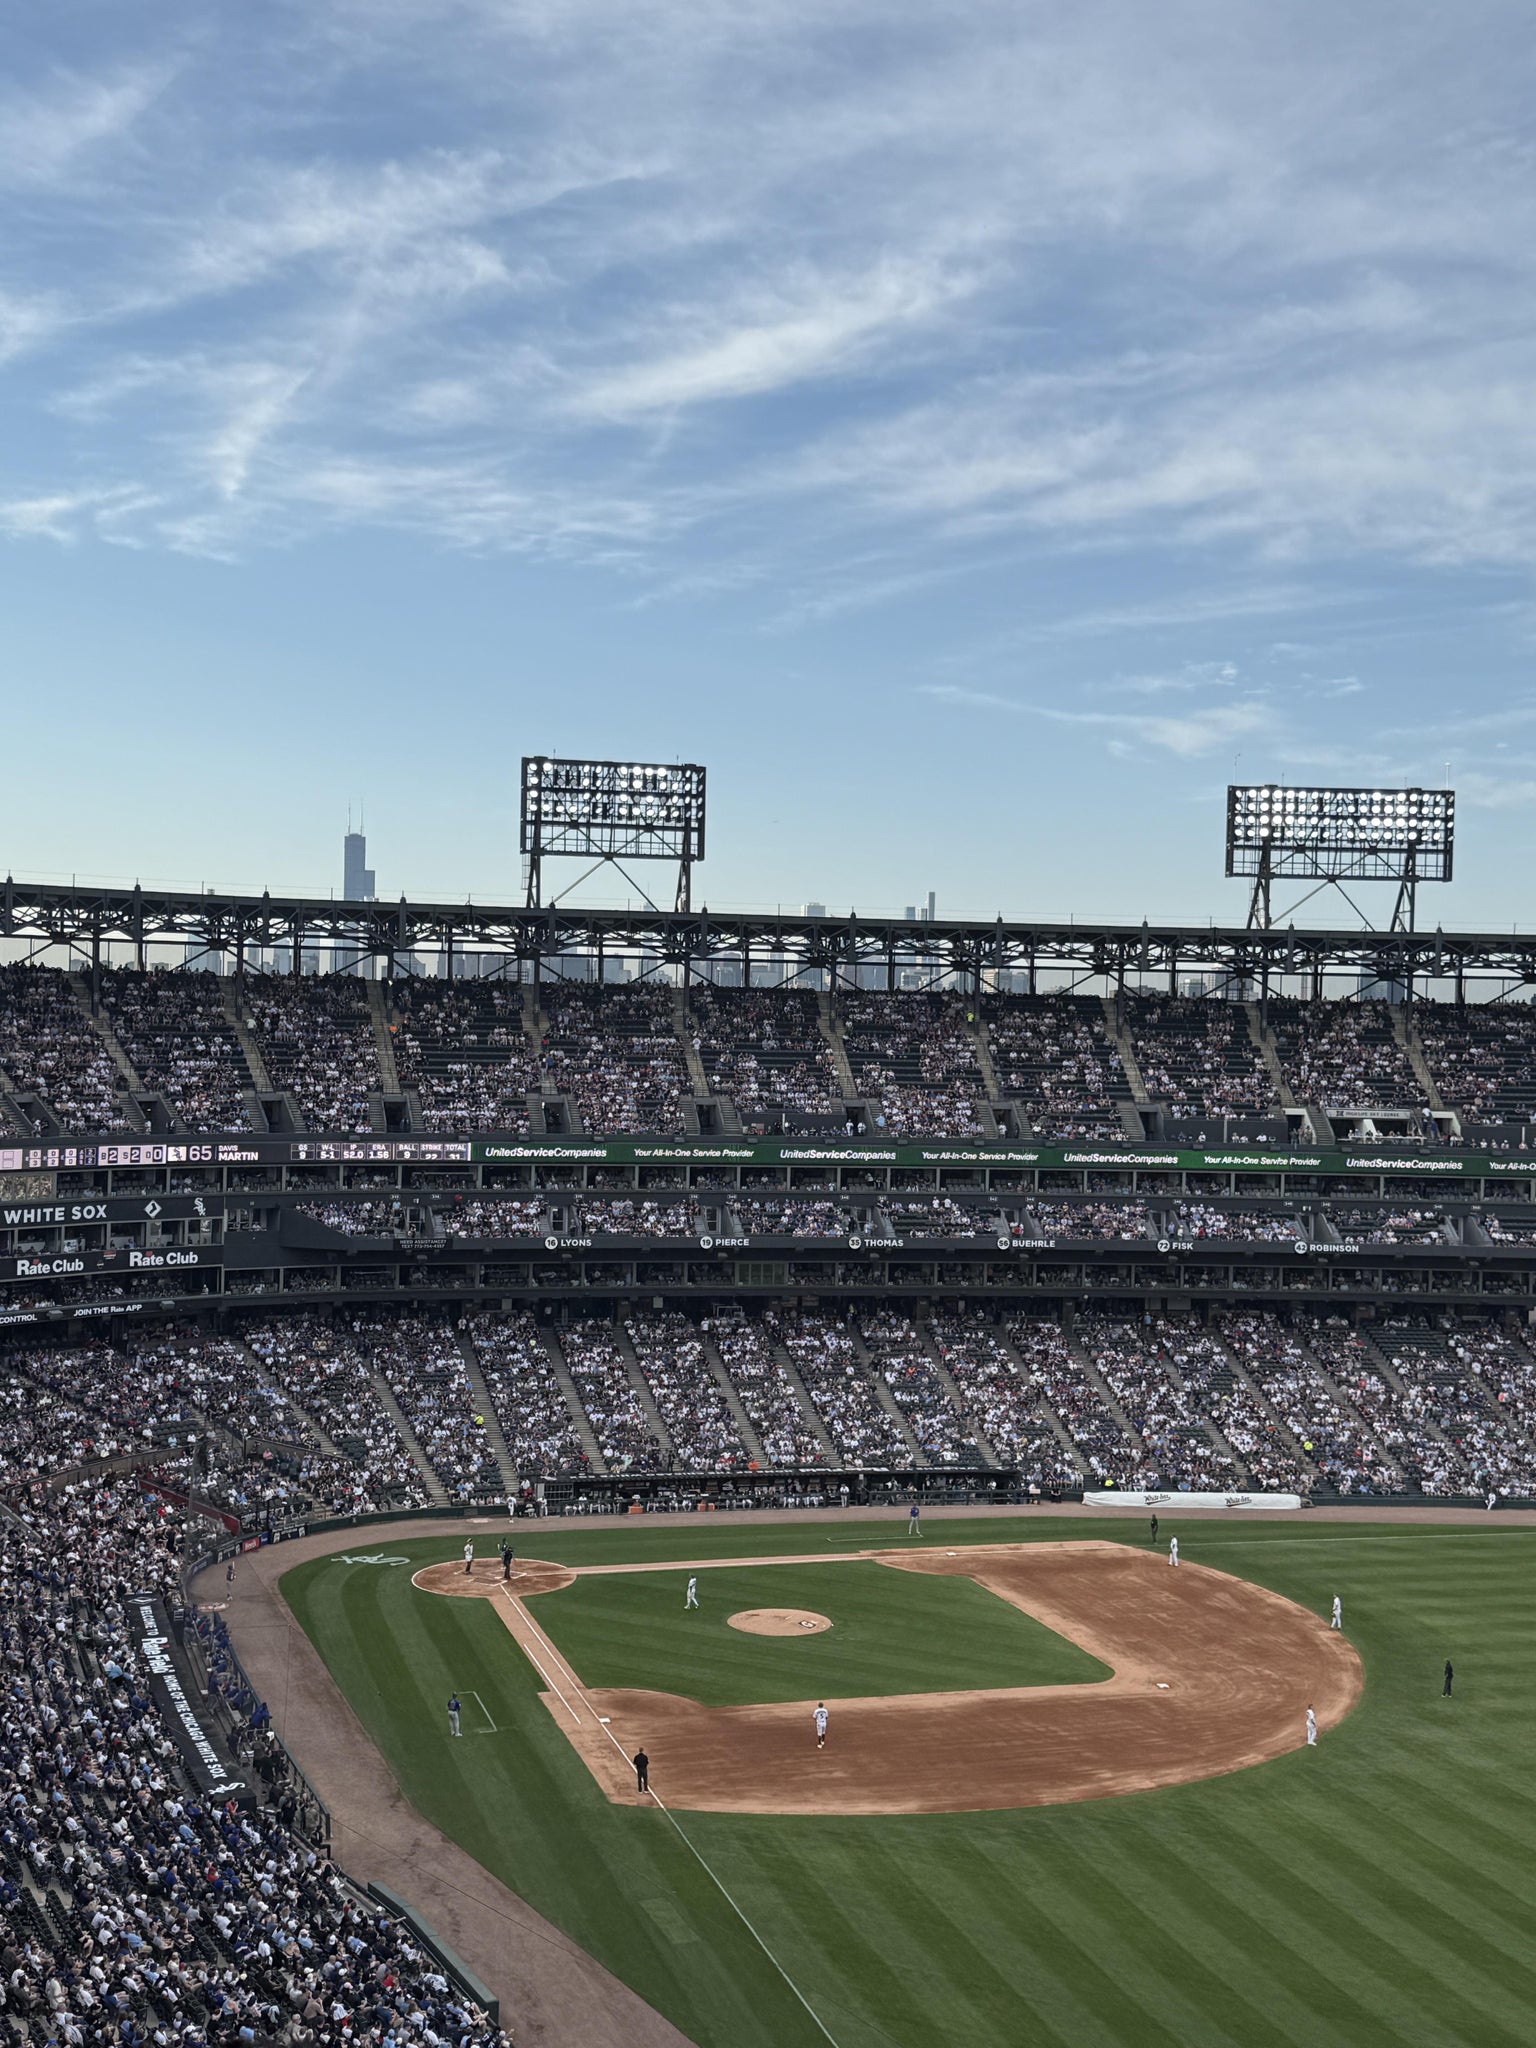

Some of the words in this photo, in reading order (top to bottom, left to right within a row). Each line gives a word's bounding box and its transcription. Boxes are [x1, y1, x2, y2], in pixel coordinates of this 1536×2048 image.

[109, 1150, 117, 1161] 2
[131, 1149, 140, 1161] 2
[154, 1149, 162, 1160] 0
[189, 1146, 212, 1161] 65
[218, 1152, 259, 1161] MARTIN
[299, 1151, 307, 1160] 9
[321, 1151, 335, 1159] 5-1
[343, 1151, 363, 1159] 52.0
[369, 1151, 390, 1159] 1.56
[404, 1151, 411, 1159] 9
[485, 1147, 607, 1159] UnitedServiceCompanies
[634, 1148, 652, 1157] Your
[653, 1149, 690, 1157] All-In-One
[692, 1149, 721, 1157] Service
[722, 1149, 755, 1158] Provider
[780, 1149, 896, 1161] UnitedServiceCompanies
[922, 1152, 940, 1160] Your
[940, 1152, 977, 1160] All-In-One
[979, 1153, 1006, 1161] Service
[1008, 1153, 1039, 1162] Provider
[1064, 1152, 1178, 1165] UnitedServiceCompanies
[1204, 1155, 1220, 1163] Your
[1221, 1156, 1259, 1164] All-In-One
[1261, 1157, 1288, 1165] Service
[1290, 1157, 1321, 1166] Provider
[1346, 1158, 1463, 1171] UnitedServiceCompanies
[1490, 1162, 1507, 1170] Your
[4, 1207, 65, 1224] WHITE
[71, 1204, 107, 1221] SOX
[547, 1239, 556, 1247] 16
[560, 1239, 592, 1247] LYONS
[702, 1238, 711, 1246] 19
[715, 1238, 750, 1246] PIERCE
[864, 1239, 904, 1247] THOMAS
[1012, 1240, 1055, 1248] BUEHRLE
[1159, 1241, 1169, 1249] 72
[1172, 1242, 1194, 1250] FISK
[1296, 1244, 1306, 1252] 42
[1310, 1244, 1359, 1253] ROBINSON
[129, 1251, 164, 1267] Rate
[166, 1251, 199, 1265] Club
[16, 1259, 51, 1276] Rate
[52, 1258, 84, 1273] Club
[73, 1308, 92, 1317] JOIN
[93, 1307, 109, 1315] THE
[126, 1304, 143, 1312] APP
[0, 1314, 38, 1324] CONTROL
[139, 1605, 157, 1629] WELCOME
[146, 1628, 159, 1636] TO
[141, 1637, 169, 1656] Rate
[146, 1654, 174, 1674] Field
[162, 1674, 182, 1692] HOME
[170, 1691, 186, 1702] OF
[174, 1699, 191, 1713] THE
[179, 1712, 206, 1741] CHICAGO
[194, 1740, 219, 1764] WHITE
[207, 1763, 228, 1779] SOX
